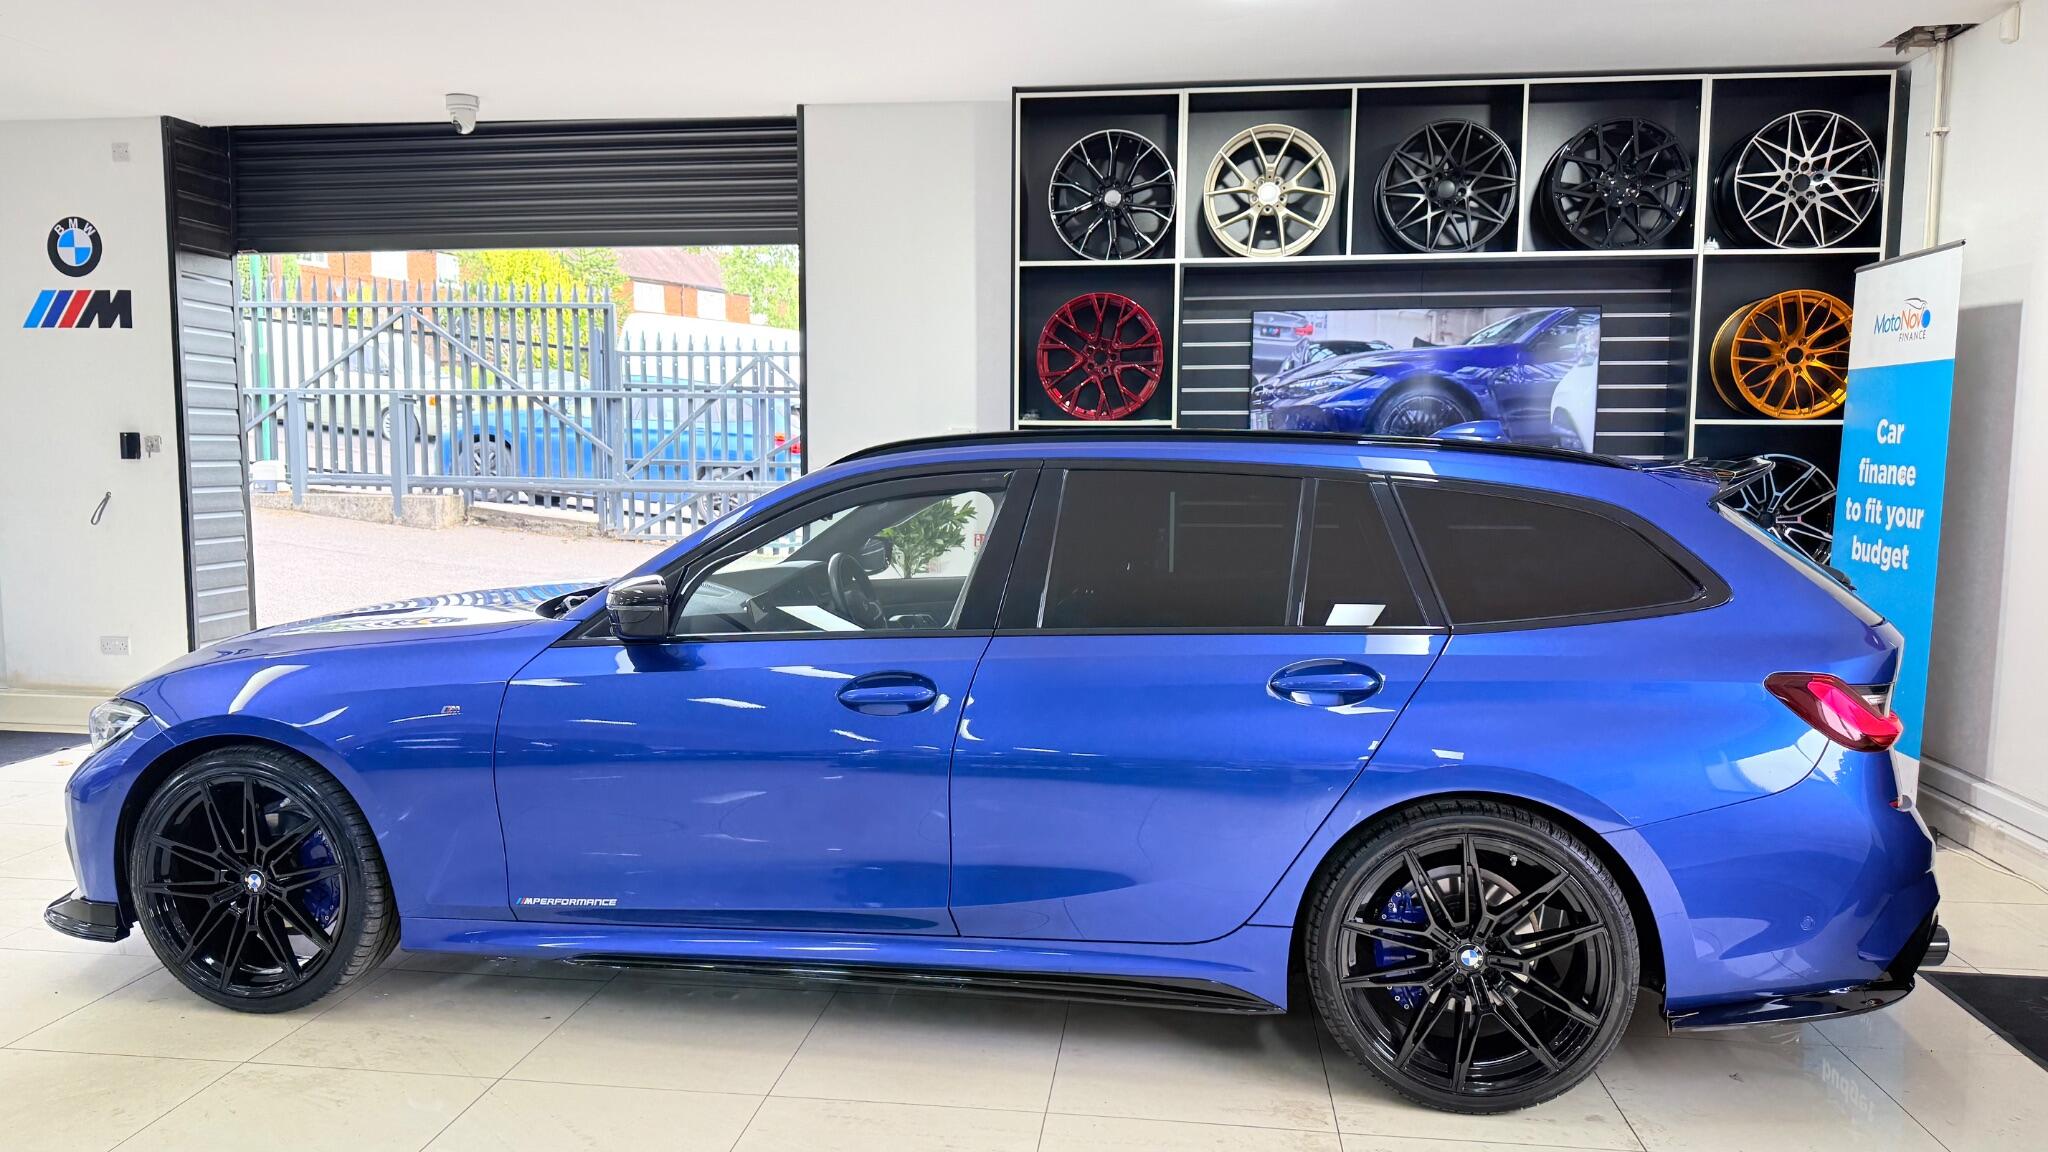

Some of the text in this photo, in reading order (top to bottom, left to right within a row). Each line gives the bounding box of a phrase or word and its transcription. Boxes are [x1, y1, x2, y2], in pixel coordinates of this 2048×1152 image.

[54, 218, 96, 236] BMW
[1899, 330, 1926, 342] FINANCE
[1876, 418, 1905, 444] Car
[1858, 457, 1917, 486] finance
[1845, 497, 1925, 531] to fit your
[1851, 535, 1910, 572] budget
